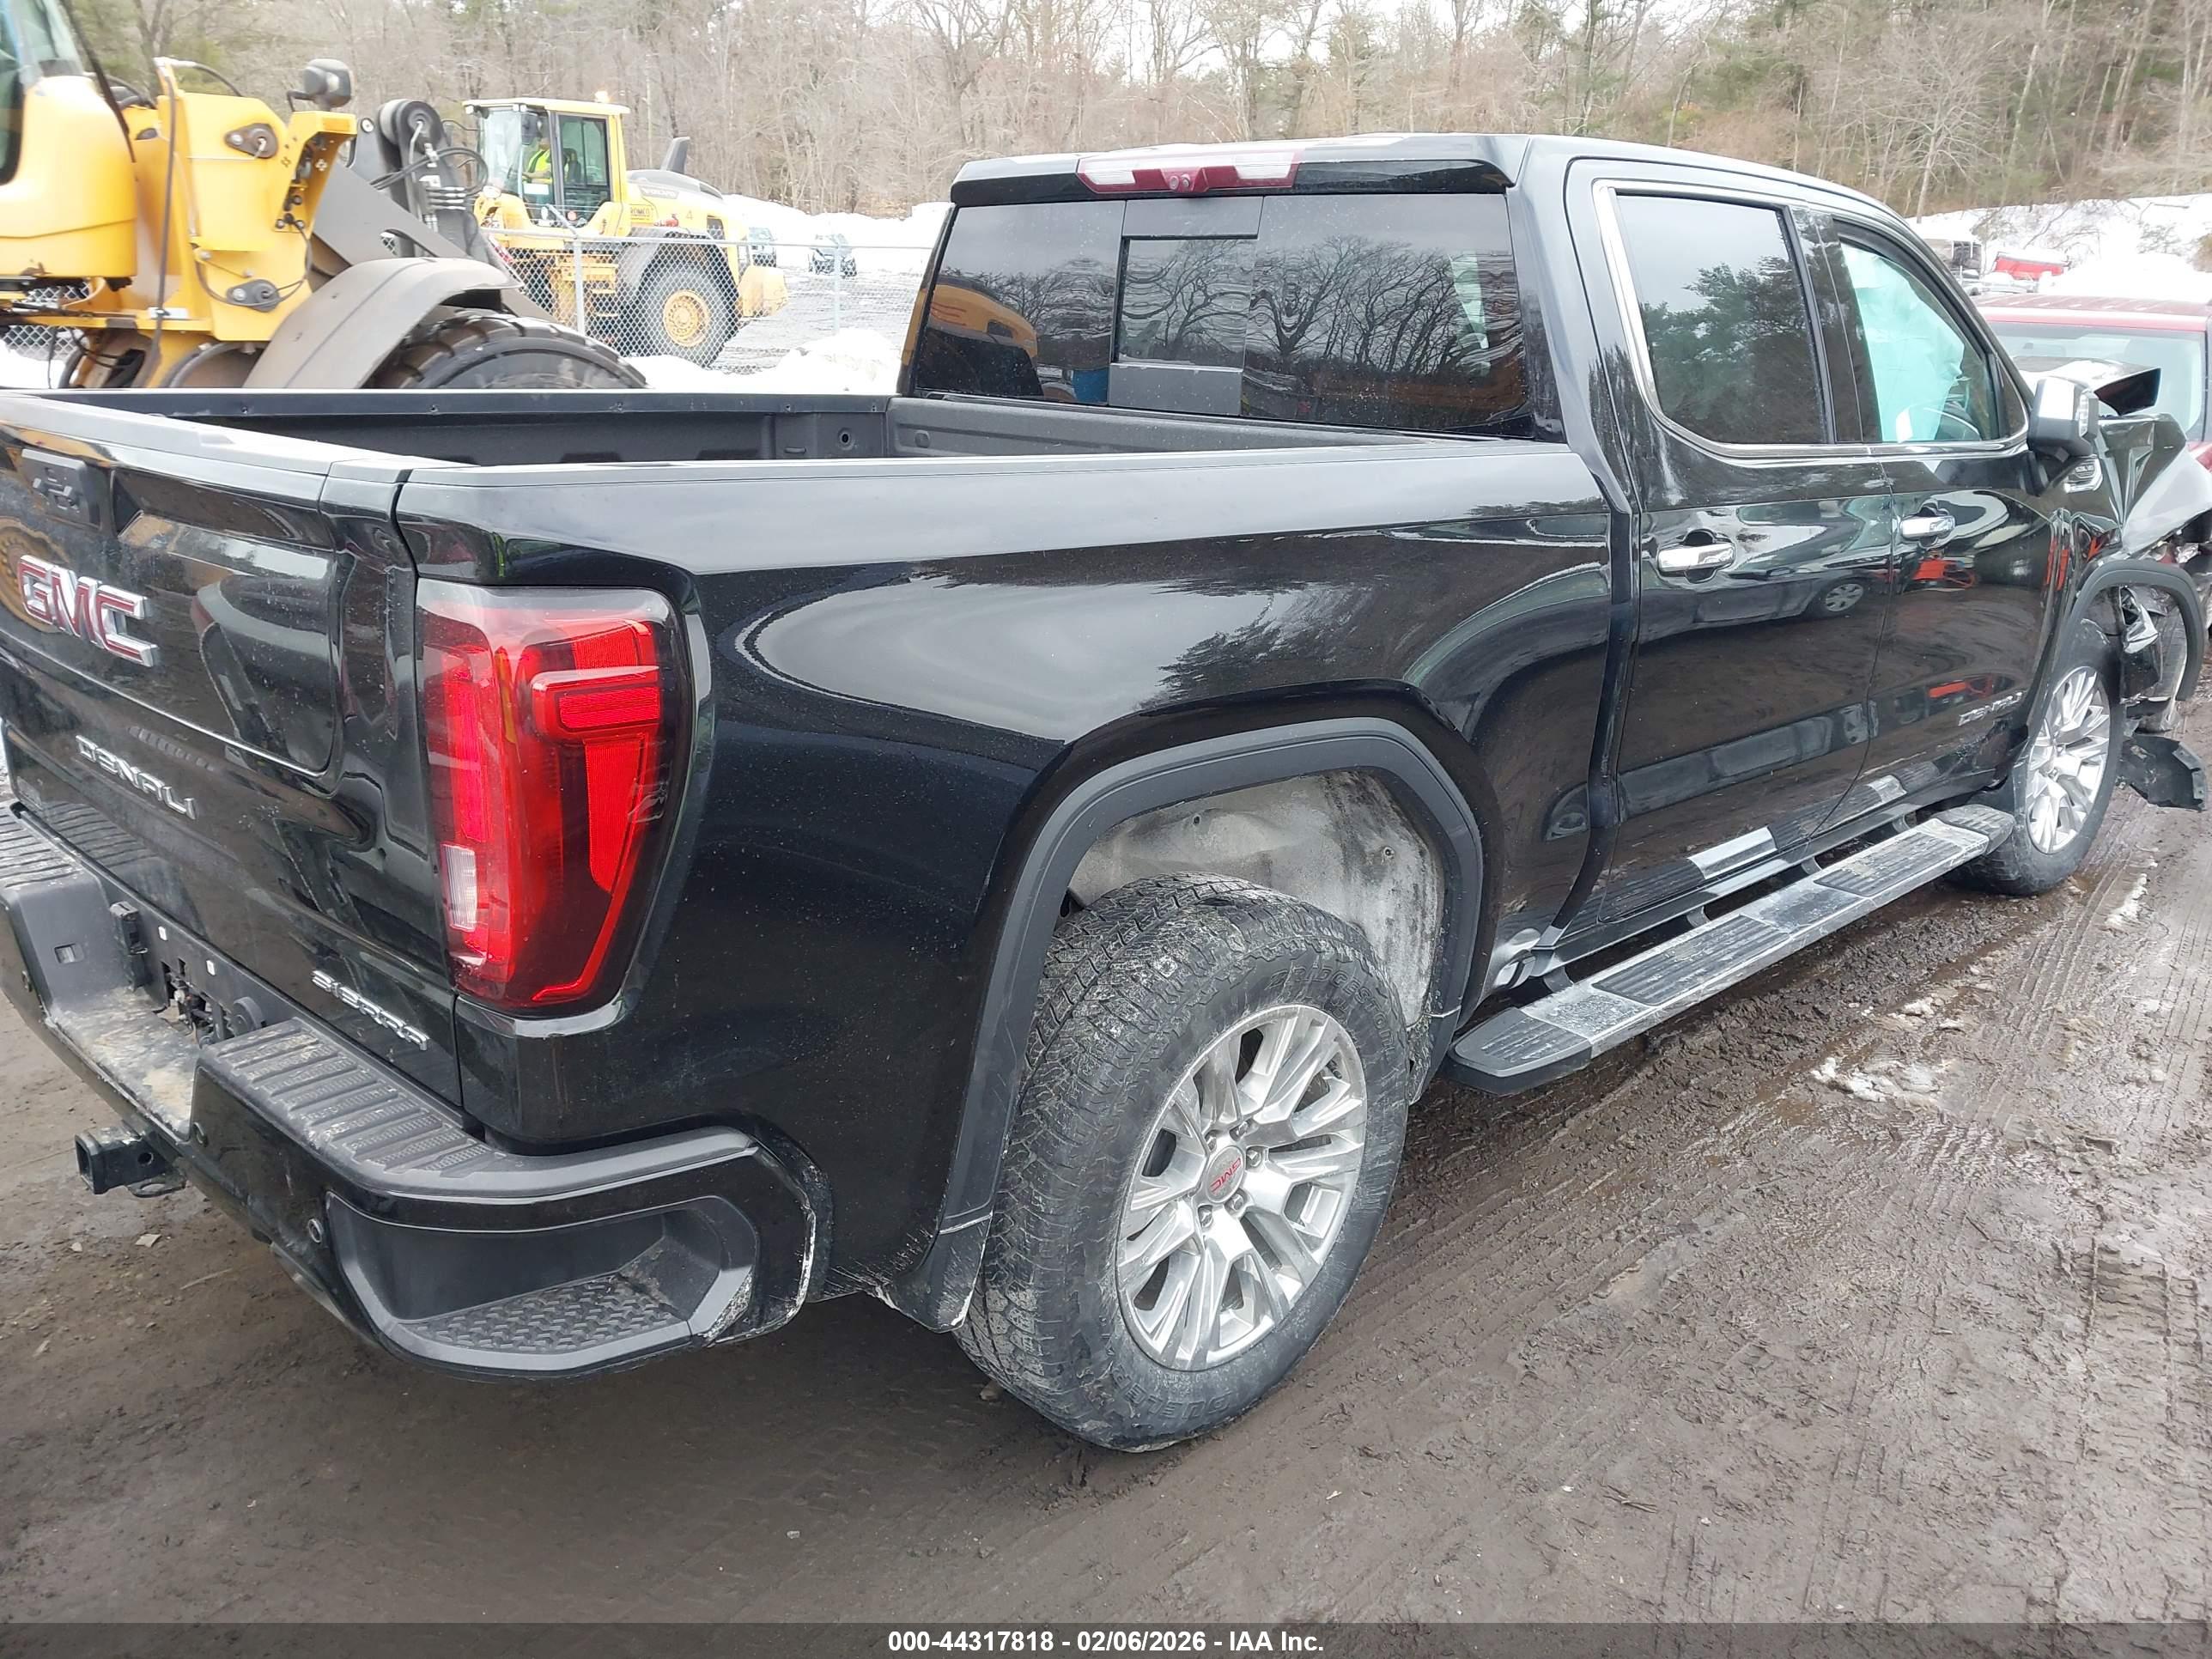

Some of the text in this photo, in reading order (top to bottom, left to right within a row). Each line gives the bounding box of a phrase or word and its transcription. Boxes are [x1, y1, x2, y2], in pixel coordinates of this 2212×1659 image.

[17, 555, 161, 667] GMC
[75, 734, 198, 820] DENALI
[311, 969, 430, 1051] SIERRA
[1209, 1157, 1243, 1193] GMC
